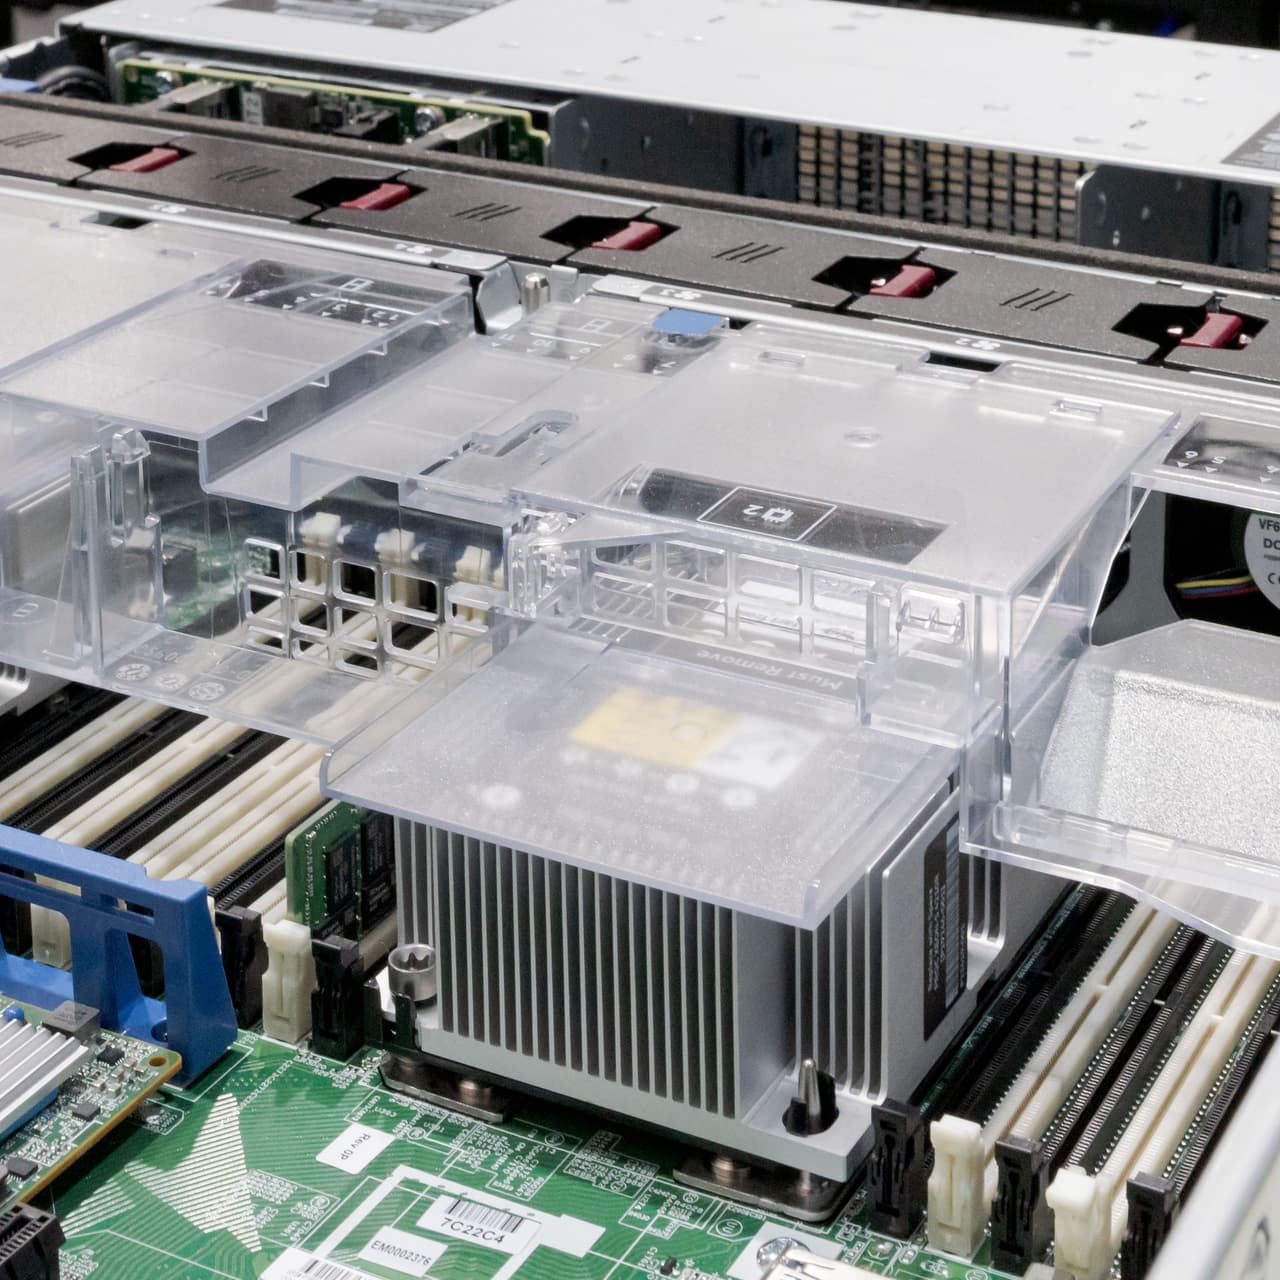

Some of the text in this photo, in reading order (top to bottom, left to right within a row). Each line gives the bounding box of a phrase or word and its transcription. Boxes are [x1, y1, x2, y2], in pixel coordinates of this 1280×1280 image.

[742, 504, 764, 516] 2
[697, 650, 843, 691] Must Remove
[349, 1132, 372, 1151] Rev
[439, 1217, 506, 1245] 7C22C4
